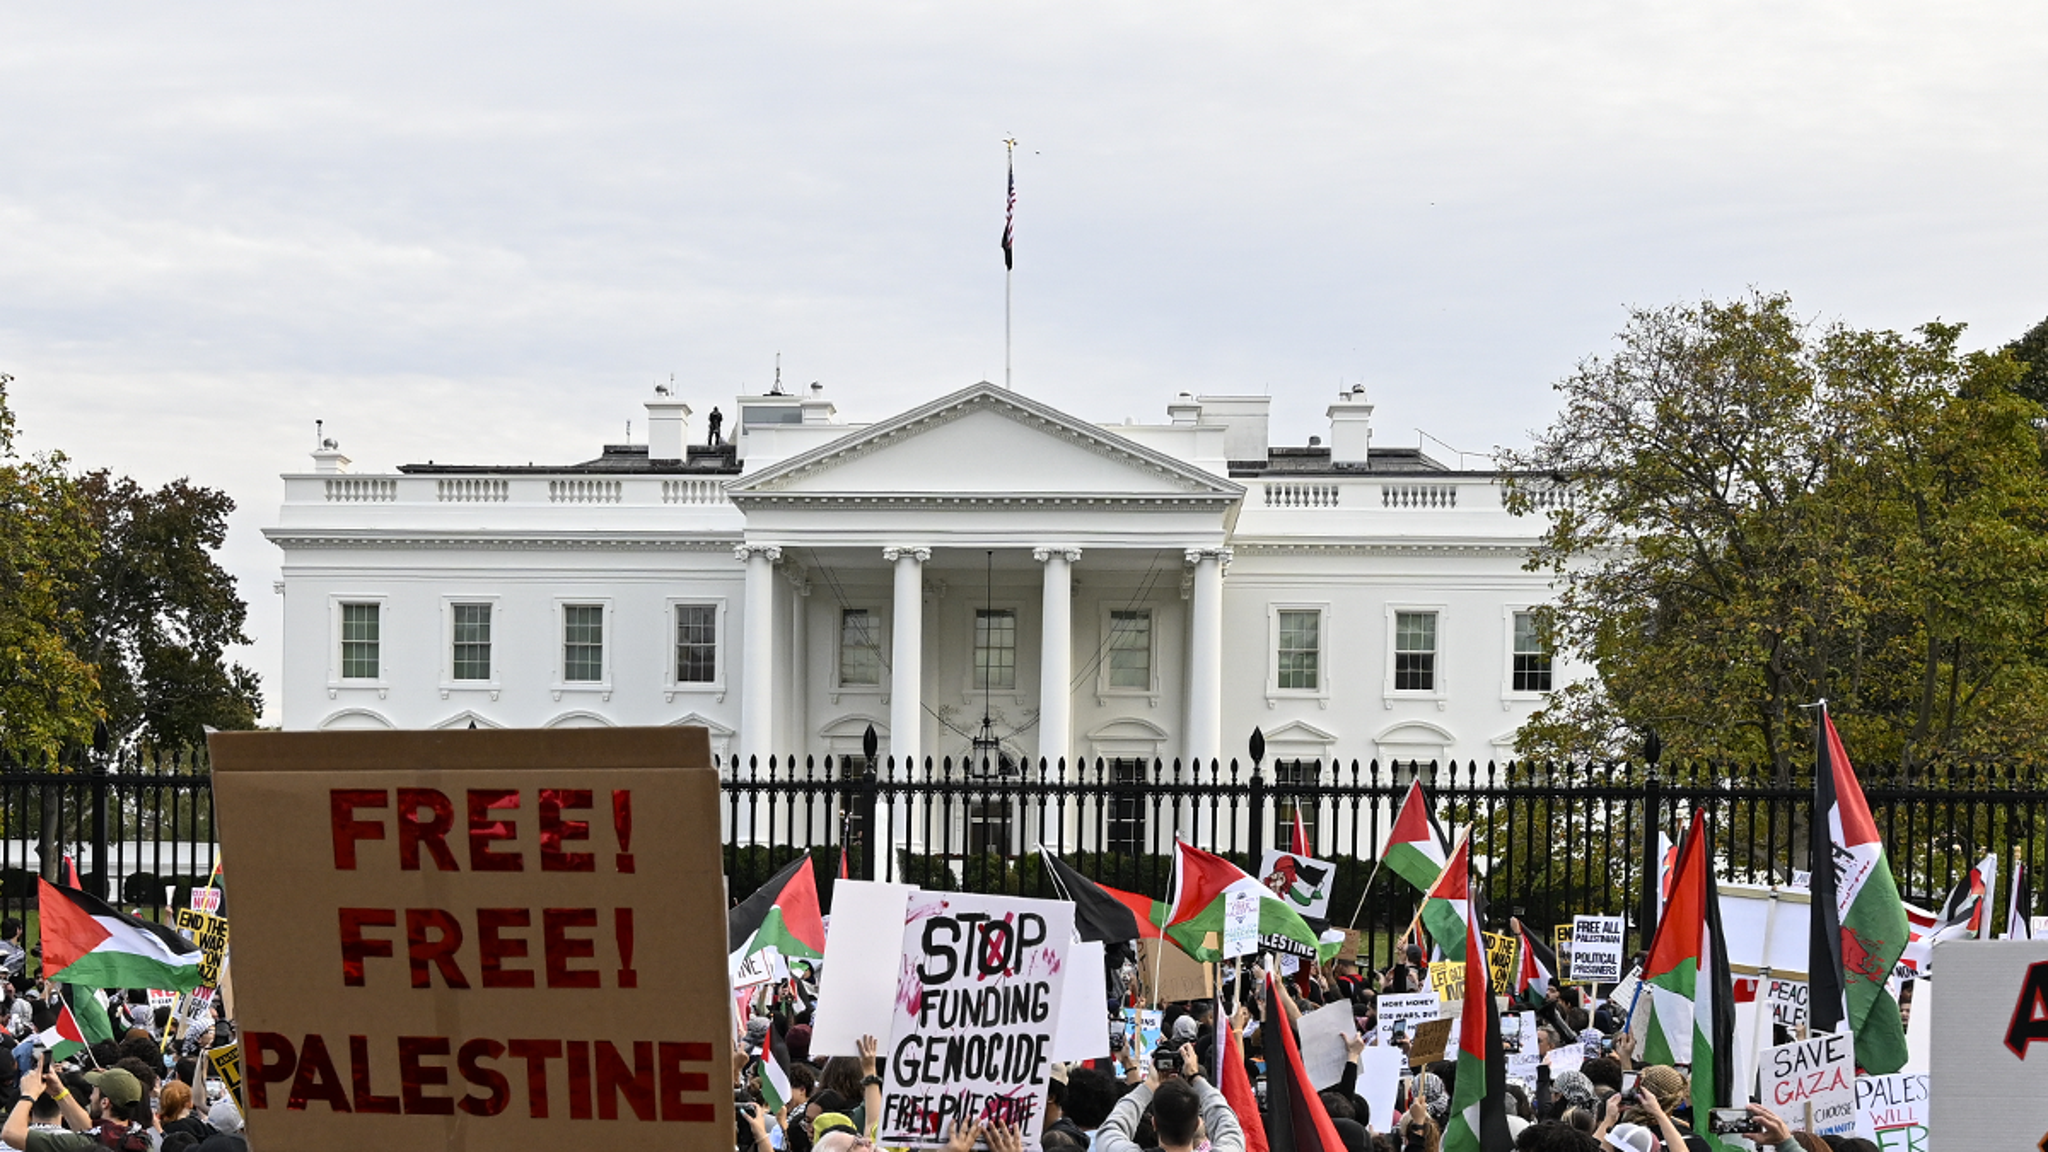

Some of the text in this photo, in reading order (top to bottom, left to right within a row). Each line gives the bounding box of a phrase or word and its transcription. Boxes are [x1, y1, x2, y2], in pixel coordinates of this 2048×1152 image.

[329, 788, 636, 874] FREE!
[193, 898, 217, 910] NOW
[179, 911, 228, 937] END THE
[1558, 927, 1574, 940] EN
[1576, 921, 1621, 934] FREE ALL
[200, 933, 224, 953] WAR
[338, 907, 638, 990] FREE!
[917, 912, 1047, 985] STOP
[1258, 933, 1315, 957] ALESTINE
[1498, 938, 1515, 955] THE
[1575, 934, 1621, 944] PALESTINIAN
[206, 952, 222, 968] ON
[1573, 965, 1617, 975] PRISONERS
[1574, 952, 1618, 965] POLITICAL
[199, 965, 217, 981] AZA
[1431, 970, 1448, 988] LET
[1768, 981, 1808, 1005] PEAC
[919, 982, 1050, 1029] FUNDING
[892, 1033, 1050, 1087] GENOCIDE
[1774, 1035, 1846, 1078] SAVE
[242, 1031, 716, 1123] PALESTINE
[1774, 1066, 1849, 1106] GAZA
[1854, 1075, 1930, 1110] PALES
[882, 1092, 934, 1136] FREE
[1814, 1101, 1853, 1124] CHOOSE
[1869, 1107, 1918, 1126] WILL
